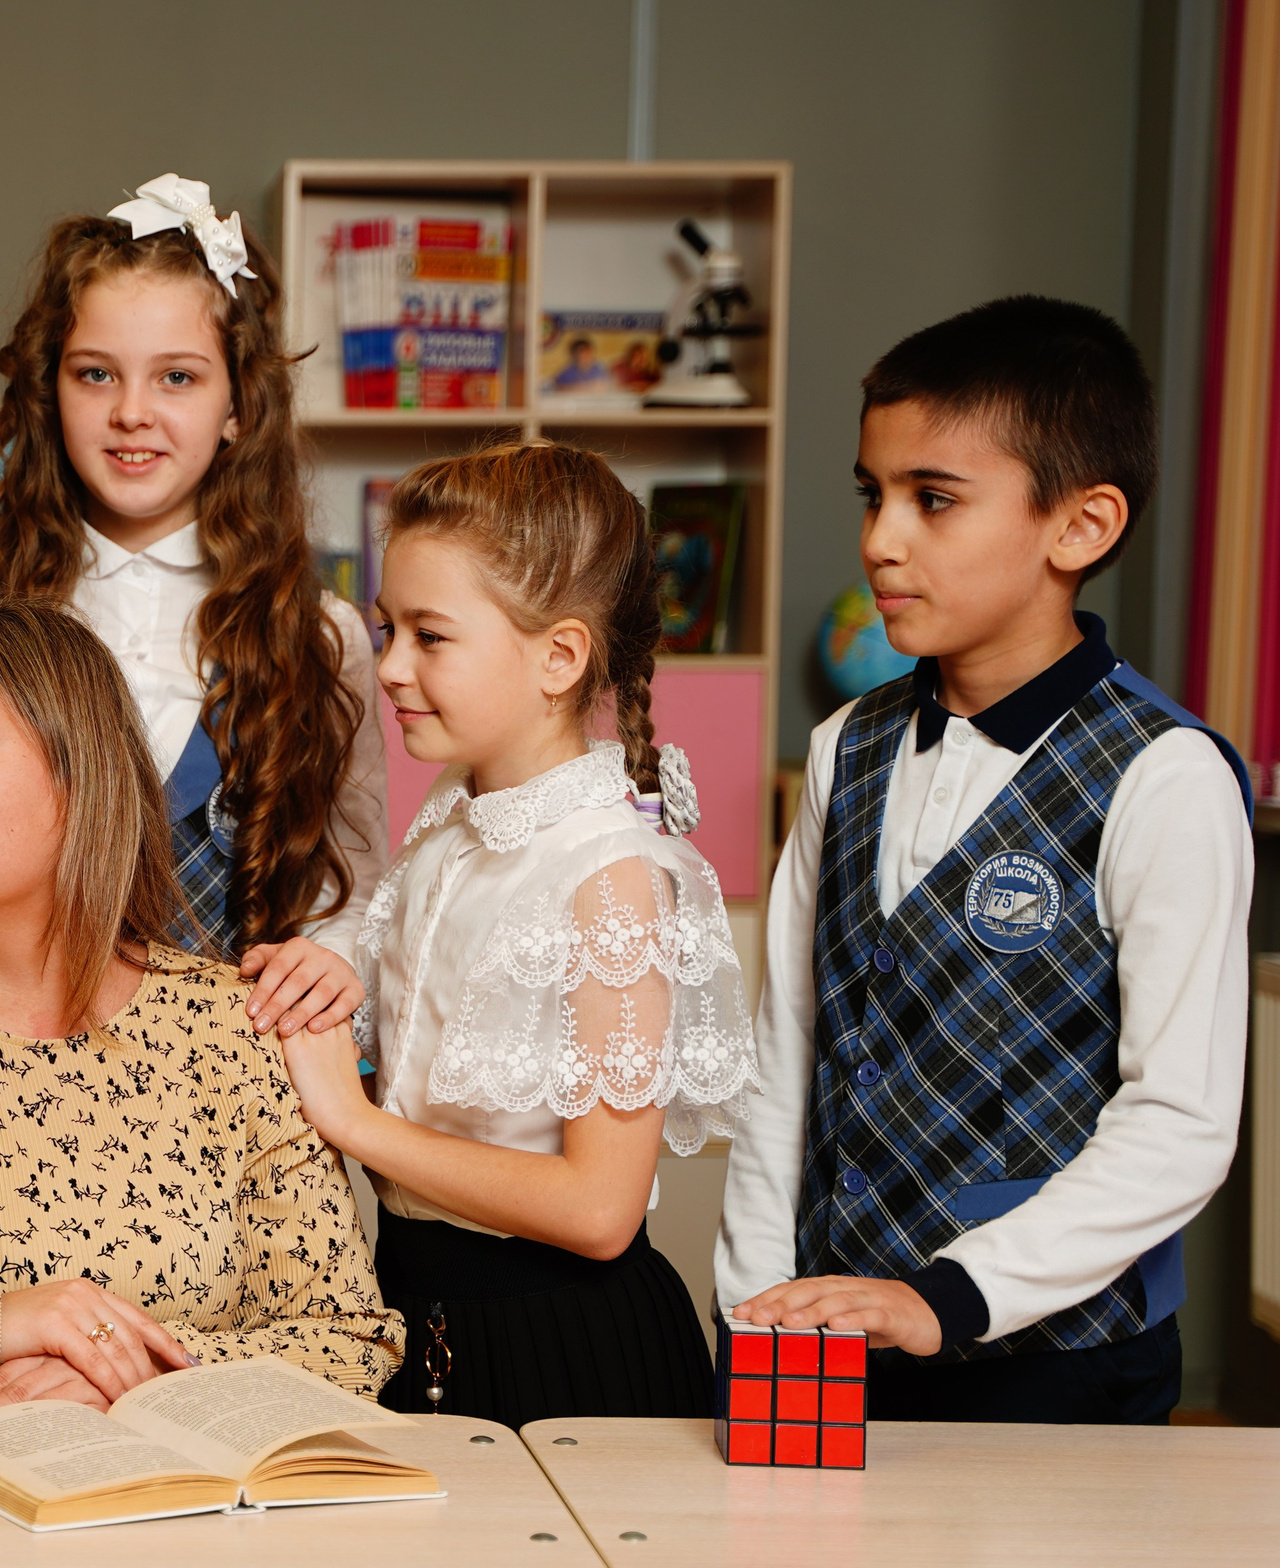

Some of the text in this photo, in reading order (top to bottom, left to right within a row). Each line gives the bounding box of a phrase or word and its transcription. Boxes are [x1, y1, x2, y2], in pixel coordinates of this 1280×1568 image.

[996, 866, 1038, 885] ШКОЛА
[968, 855, 1060, 931] ТЕРРИТОРИЯ ВОЗМОЖНОСТЕЙ
[993, 891, 1013, 909] 75
